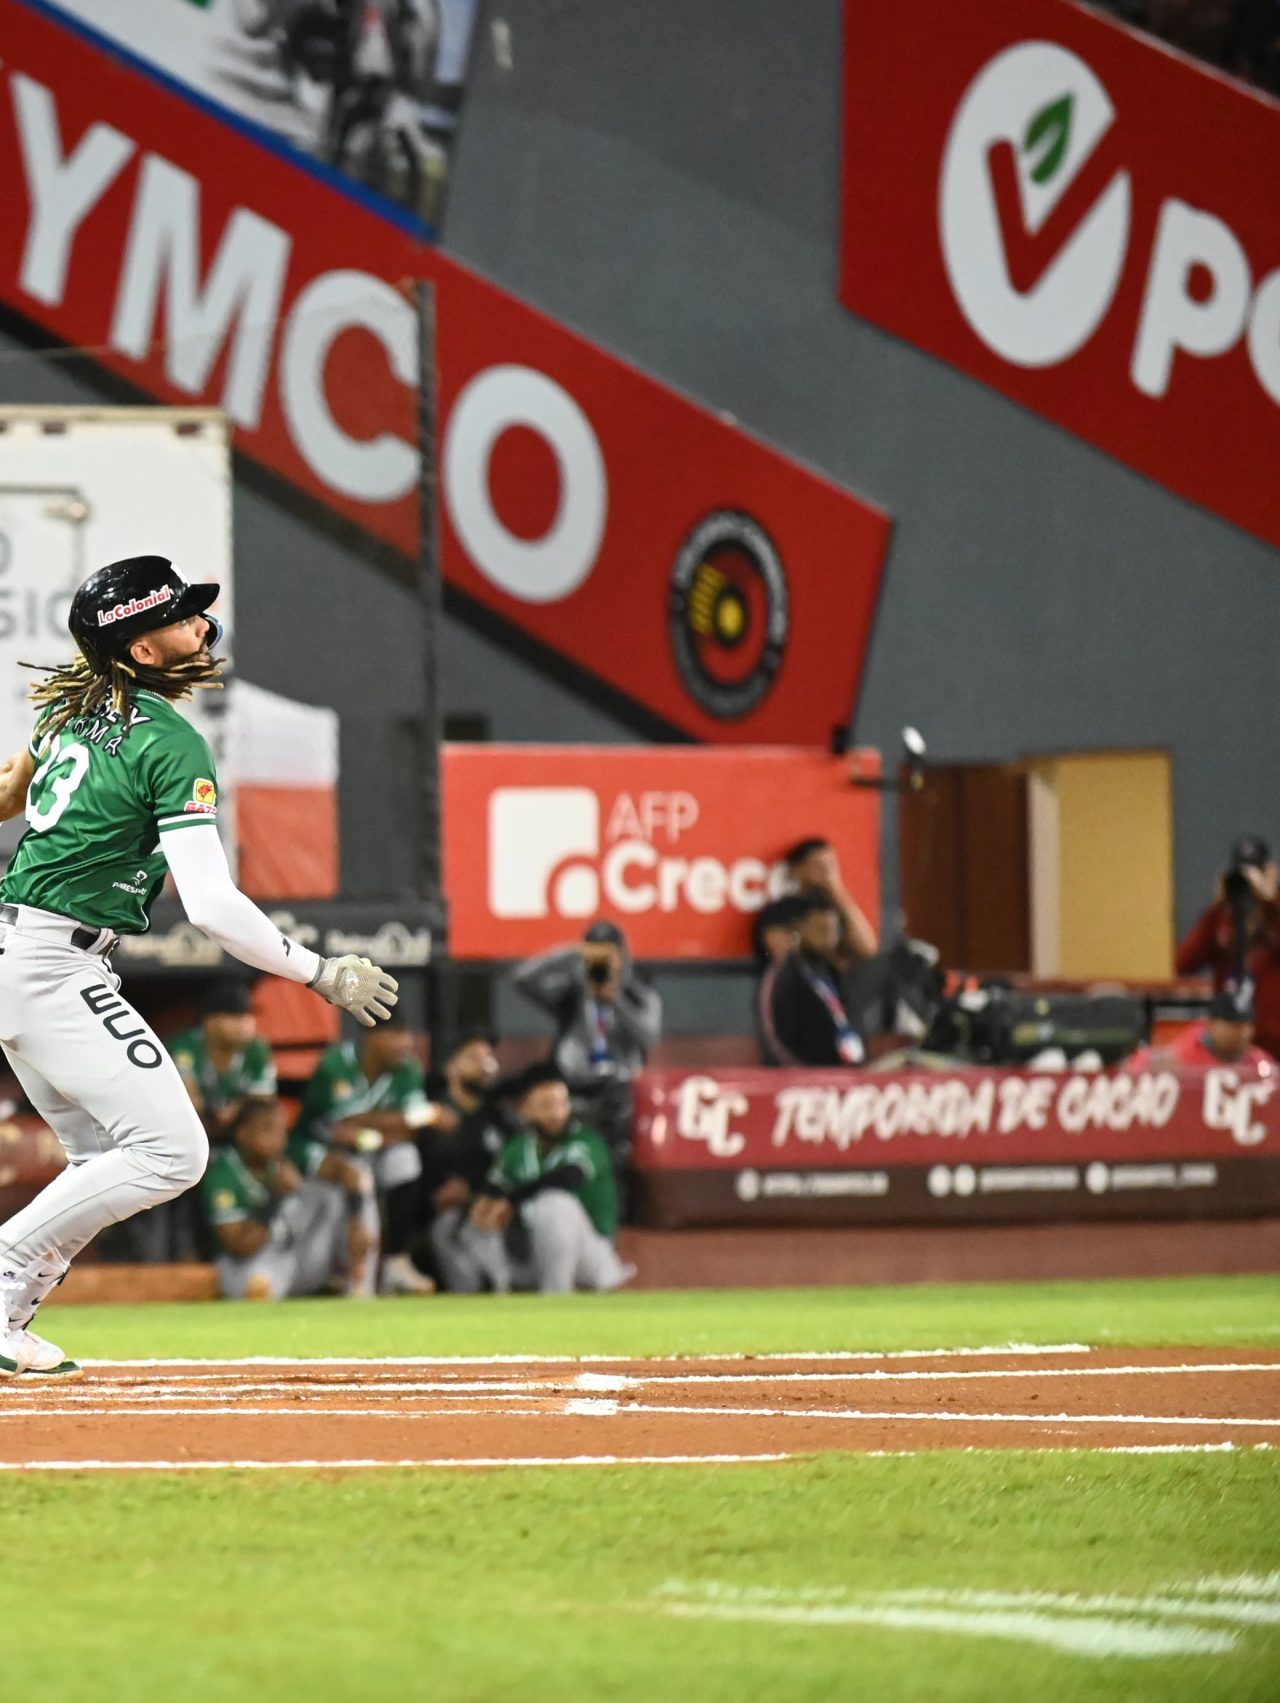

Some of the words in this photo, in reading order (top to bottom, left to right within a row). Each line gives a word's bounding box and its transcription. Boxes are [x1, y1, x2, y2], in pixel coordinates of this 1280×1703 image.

[606, 790, 700, 843] AFP
[676, 1076, 748, 1158] GC
[997, 1075, 1056, 1135] DE
[1056, 1072, 1181, 1135] CACAO
[1203, 1069, 1269, 1147] GC
